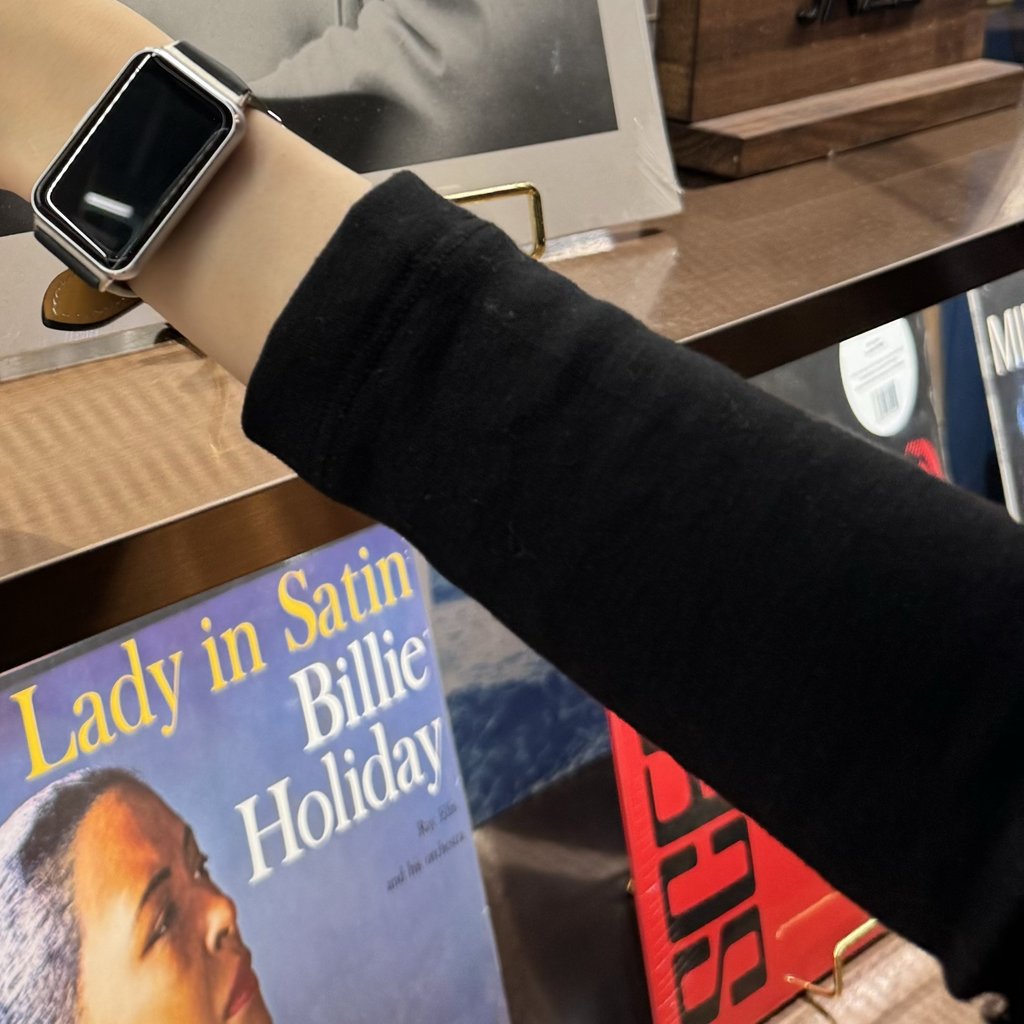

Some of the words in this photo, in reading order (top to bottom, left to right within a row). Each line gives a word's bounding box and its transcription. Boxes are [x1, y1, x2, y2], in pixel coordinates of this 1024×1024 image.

[10, 638, 183, 781] Lady
[201, 617, 267, 692] in
[278, 546, 414, 652] Satin
[290, 629, 429, 751] Billie
[235, 717, 443, 884] Holiday
